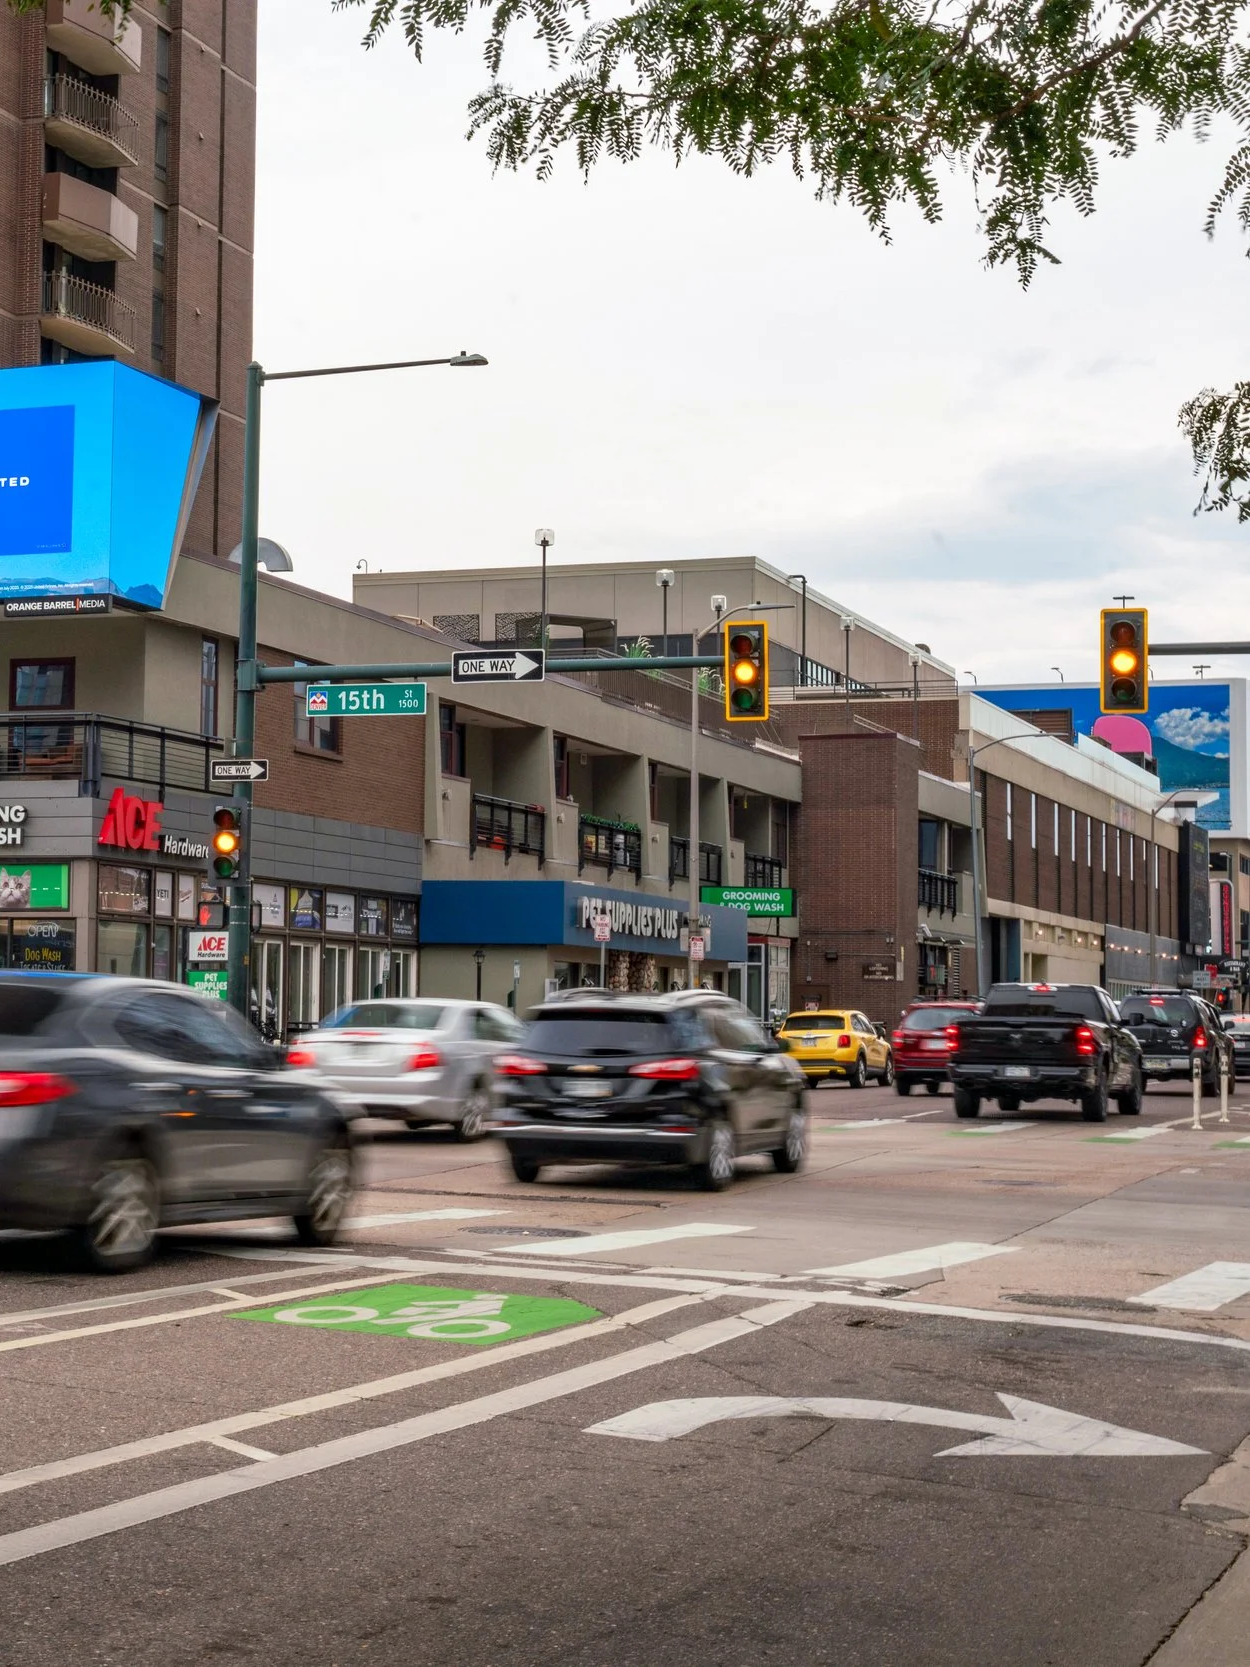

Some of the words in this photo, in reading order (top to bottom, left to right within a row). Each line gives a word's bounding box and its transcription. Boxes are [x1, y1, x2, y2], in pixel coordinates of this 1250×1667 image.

[6, 602, 42, 612] ORANGE
[43, 600, 76, 610] BARREL
[79, 600, 106, 608] MEDIA
[462, 661, 485, 673] ONE
[490, 660, 515, 672] WAY
[338, 689, 385, 710] 15th
[404, 690, 413, 698] St
[399, 699, 419, 708] 1500
[217, 767, 233, 775] ONE
[235, 767, 250, 775] WAY
[99, 788, 164, 850] ACE
[722, 891, 781, 901] GROOMING
[754, 903, 784, 912] WASH
[605, 900, 653, 937] SUPPLIES
[653, 907, 679, 939] PLUS
[27, 924, 59, 938] OPEN
[197, 935, 226, 952] ACE
[204, 973, 218, 982] PET
[194, 981, 227, 991] SUPPLIES
